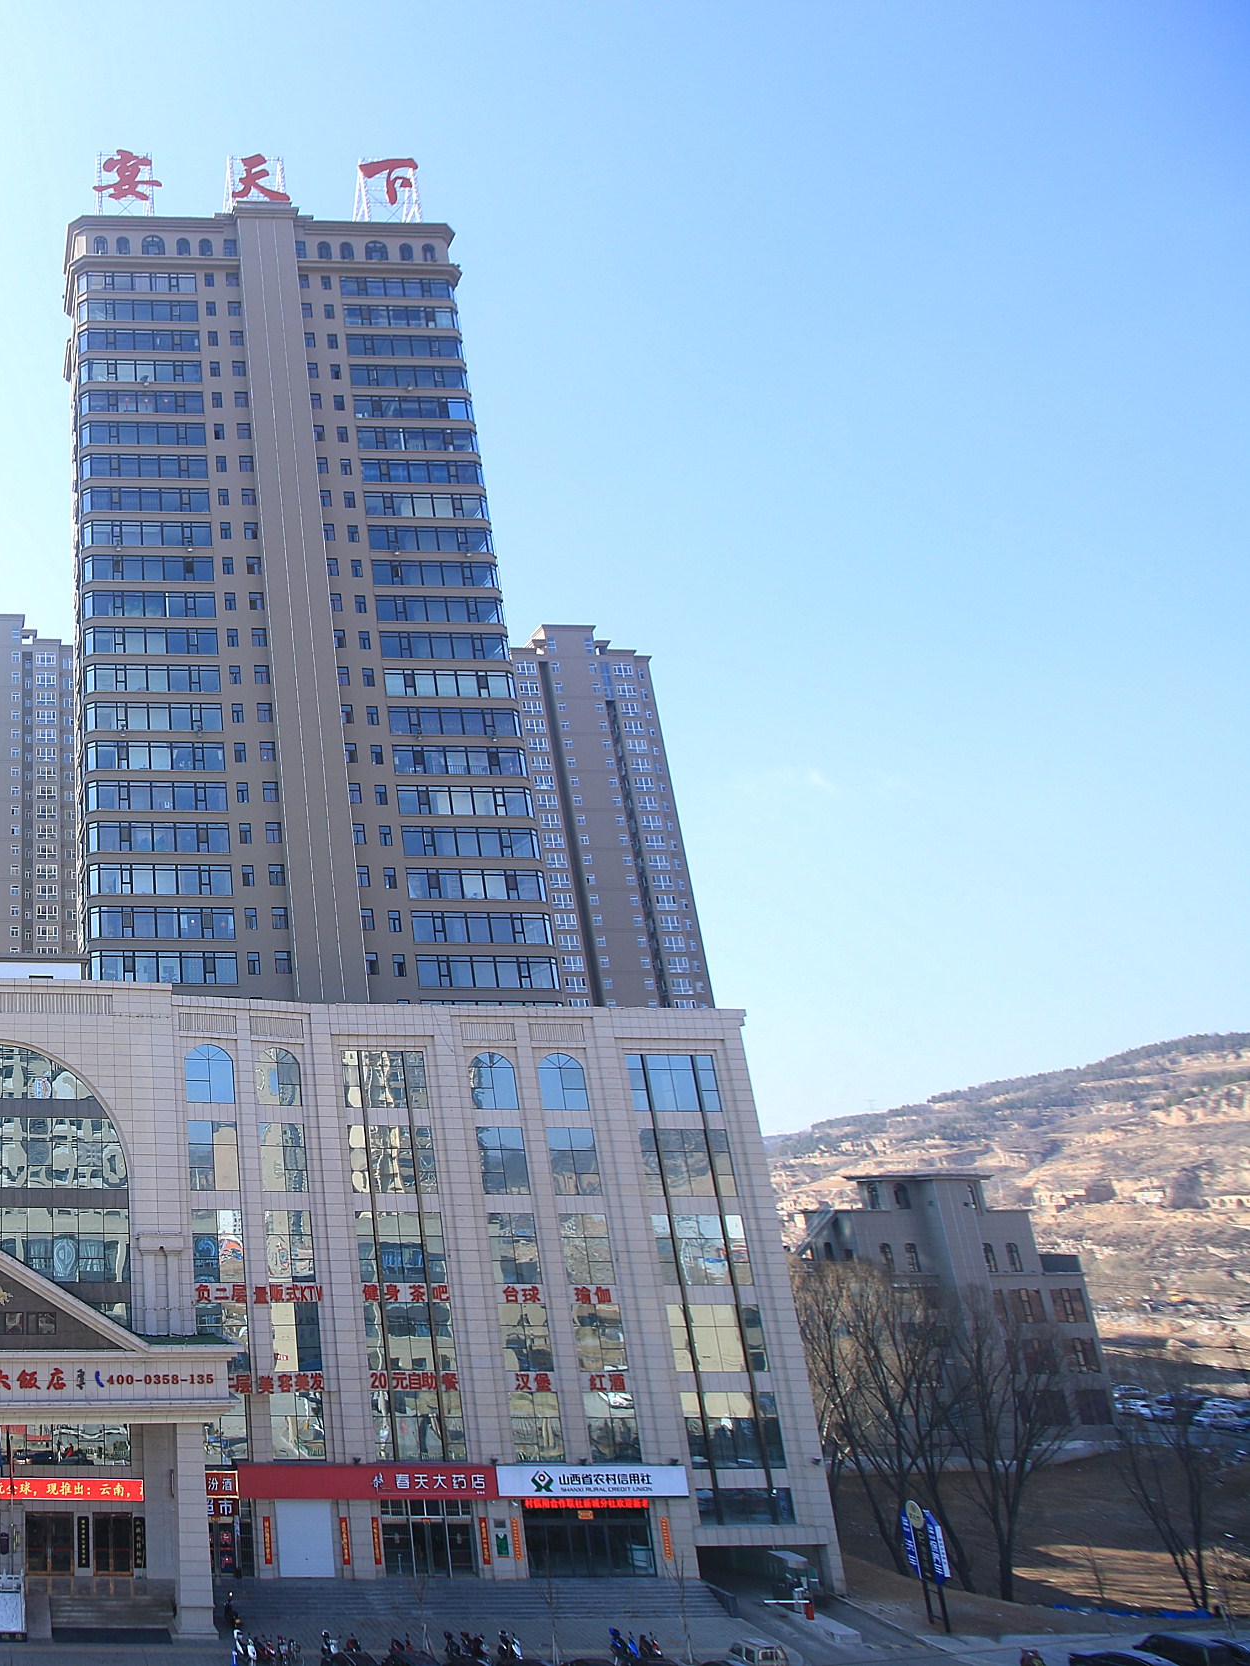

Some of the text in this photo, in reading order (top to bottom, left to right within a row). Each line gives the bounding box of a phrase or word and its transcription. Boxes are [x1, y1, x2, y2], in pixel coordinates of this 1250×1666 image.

[93, 149, 419, 205] 宴天下
[362, 1284, 450, 1302] 健身茶吧
[503, 1286, 541, 1303] 台球
[574, 1286, 612, 1304] 瑜伽
[106, 1373, 215, 1386] 400-0358-135
[370, 1372, 459, 1391] 20元自助餐
[515, 1373, 552, 1391] 汉堡
[588, 1373, 626, 1391] 红酒
[207, 1477, 233, 1491] 汾酒
[395, 1473, 486, 1489] 春天大药店
[558, 1472, 653, 1485] 山西省农村信用社
